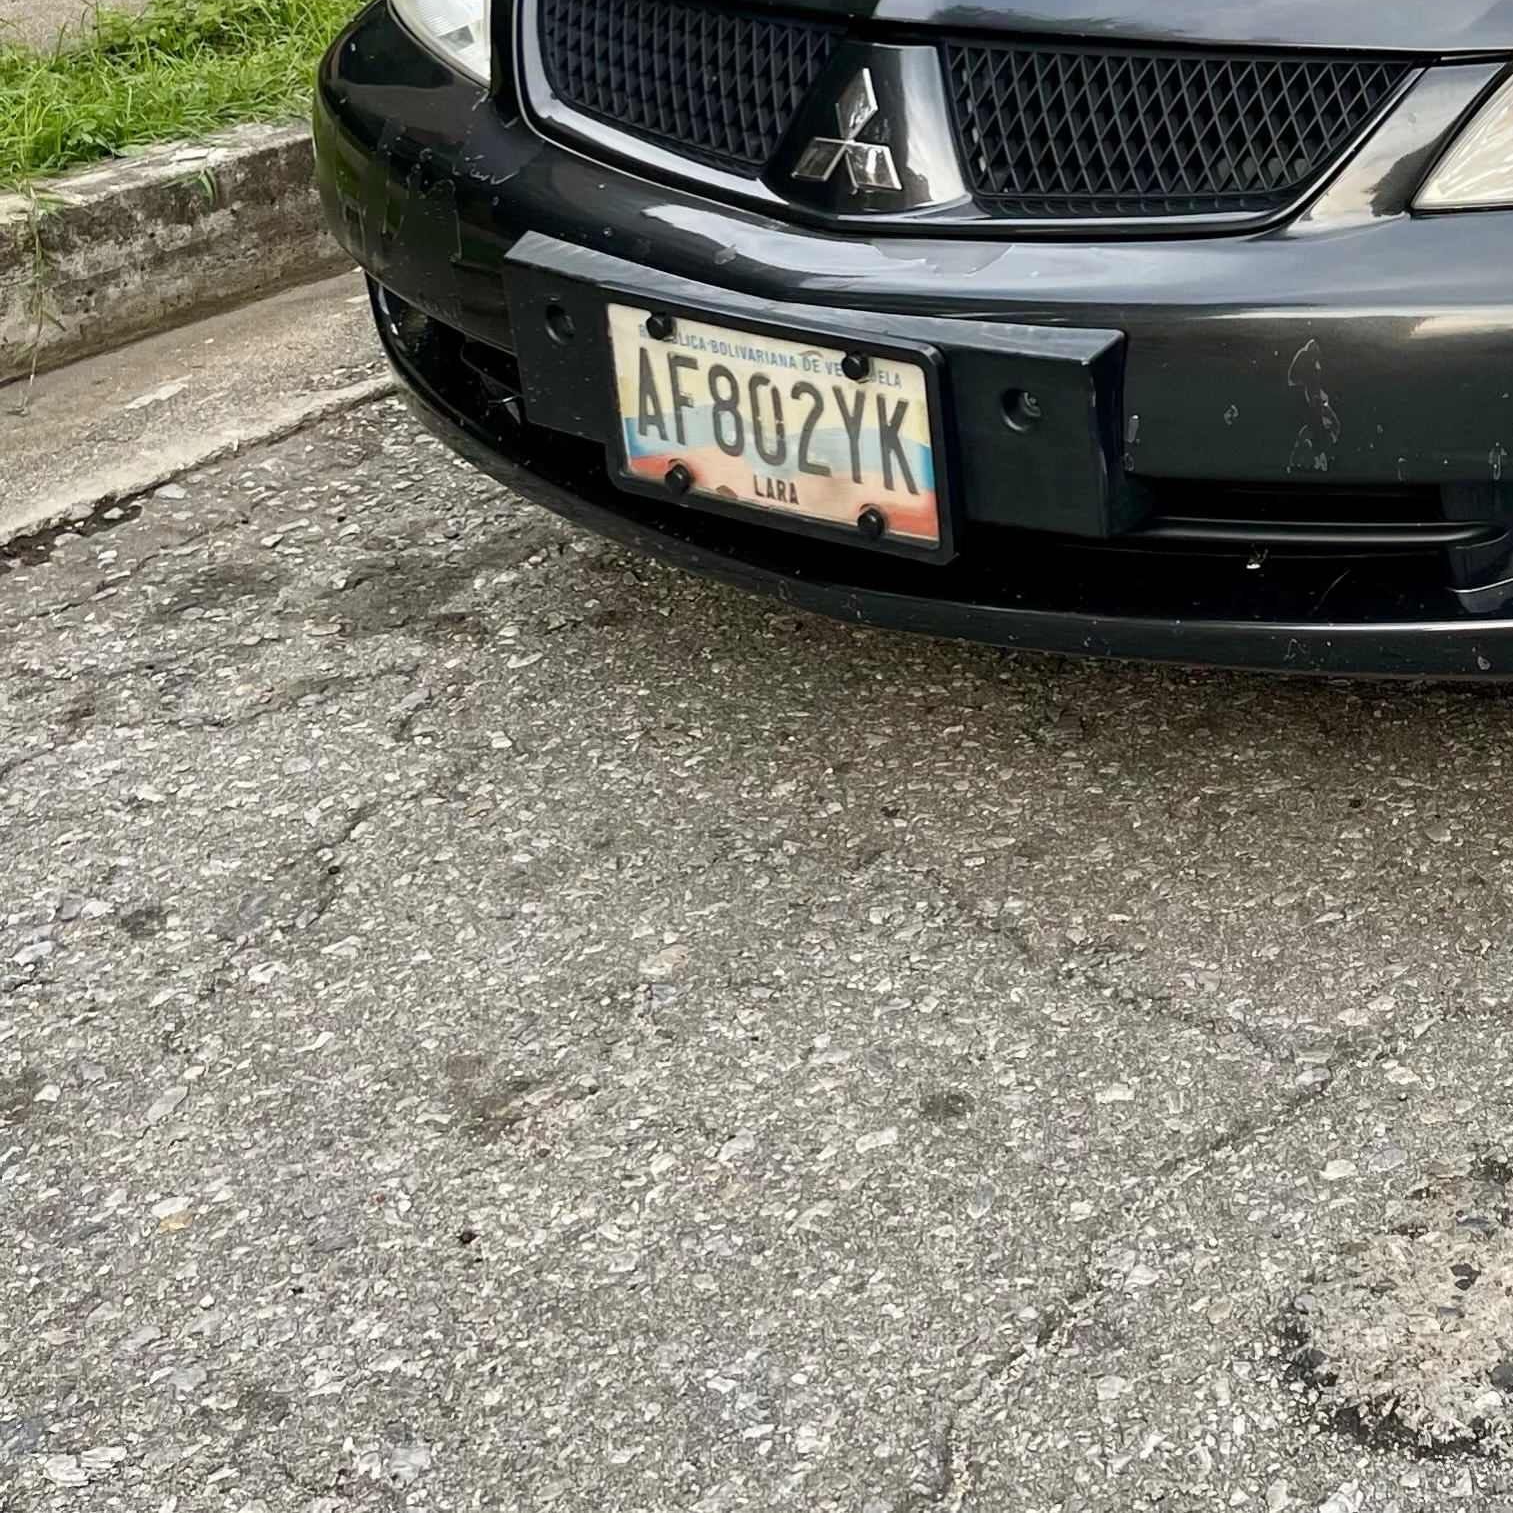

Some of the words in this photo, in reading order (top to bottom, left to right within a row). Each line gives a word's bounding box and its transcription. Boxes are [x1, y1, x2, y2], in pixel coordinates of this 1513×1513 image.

[638, 323, 707, 351] RLICA
[710, 340, 798, 370] BOLIVARIANA
[802, 356, 821, 373] DE
[825, 360, 903, 388] VEELA
[637, 346, 921, 495] AF802YK
[753, 473, 800, 505] LARA
